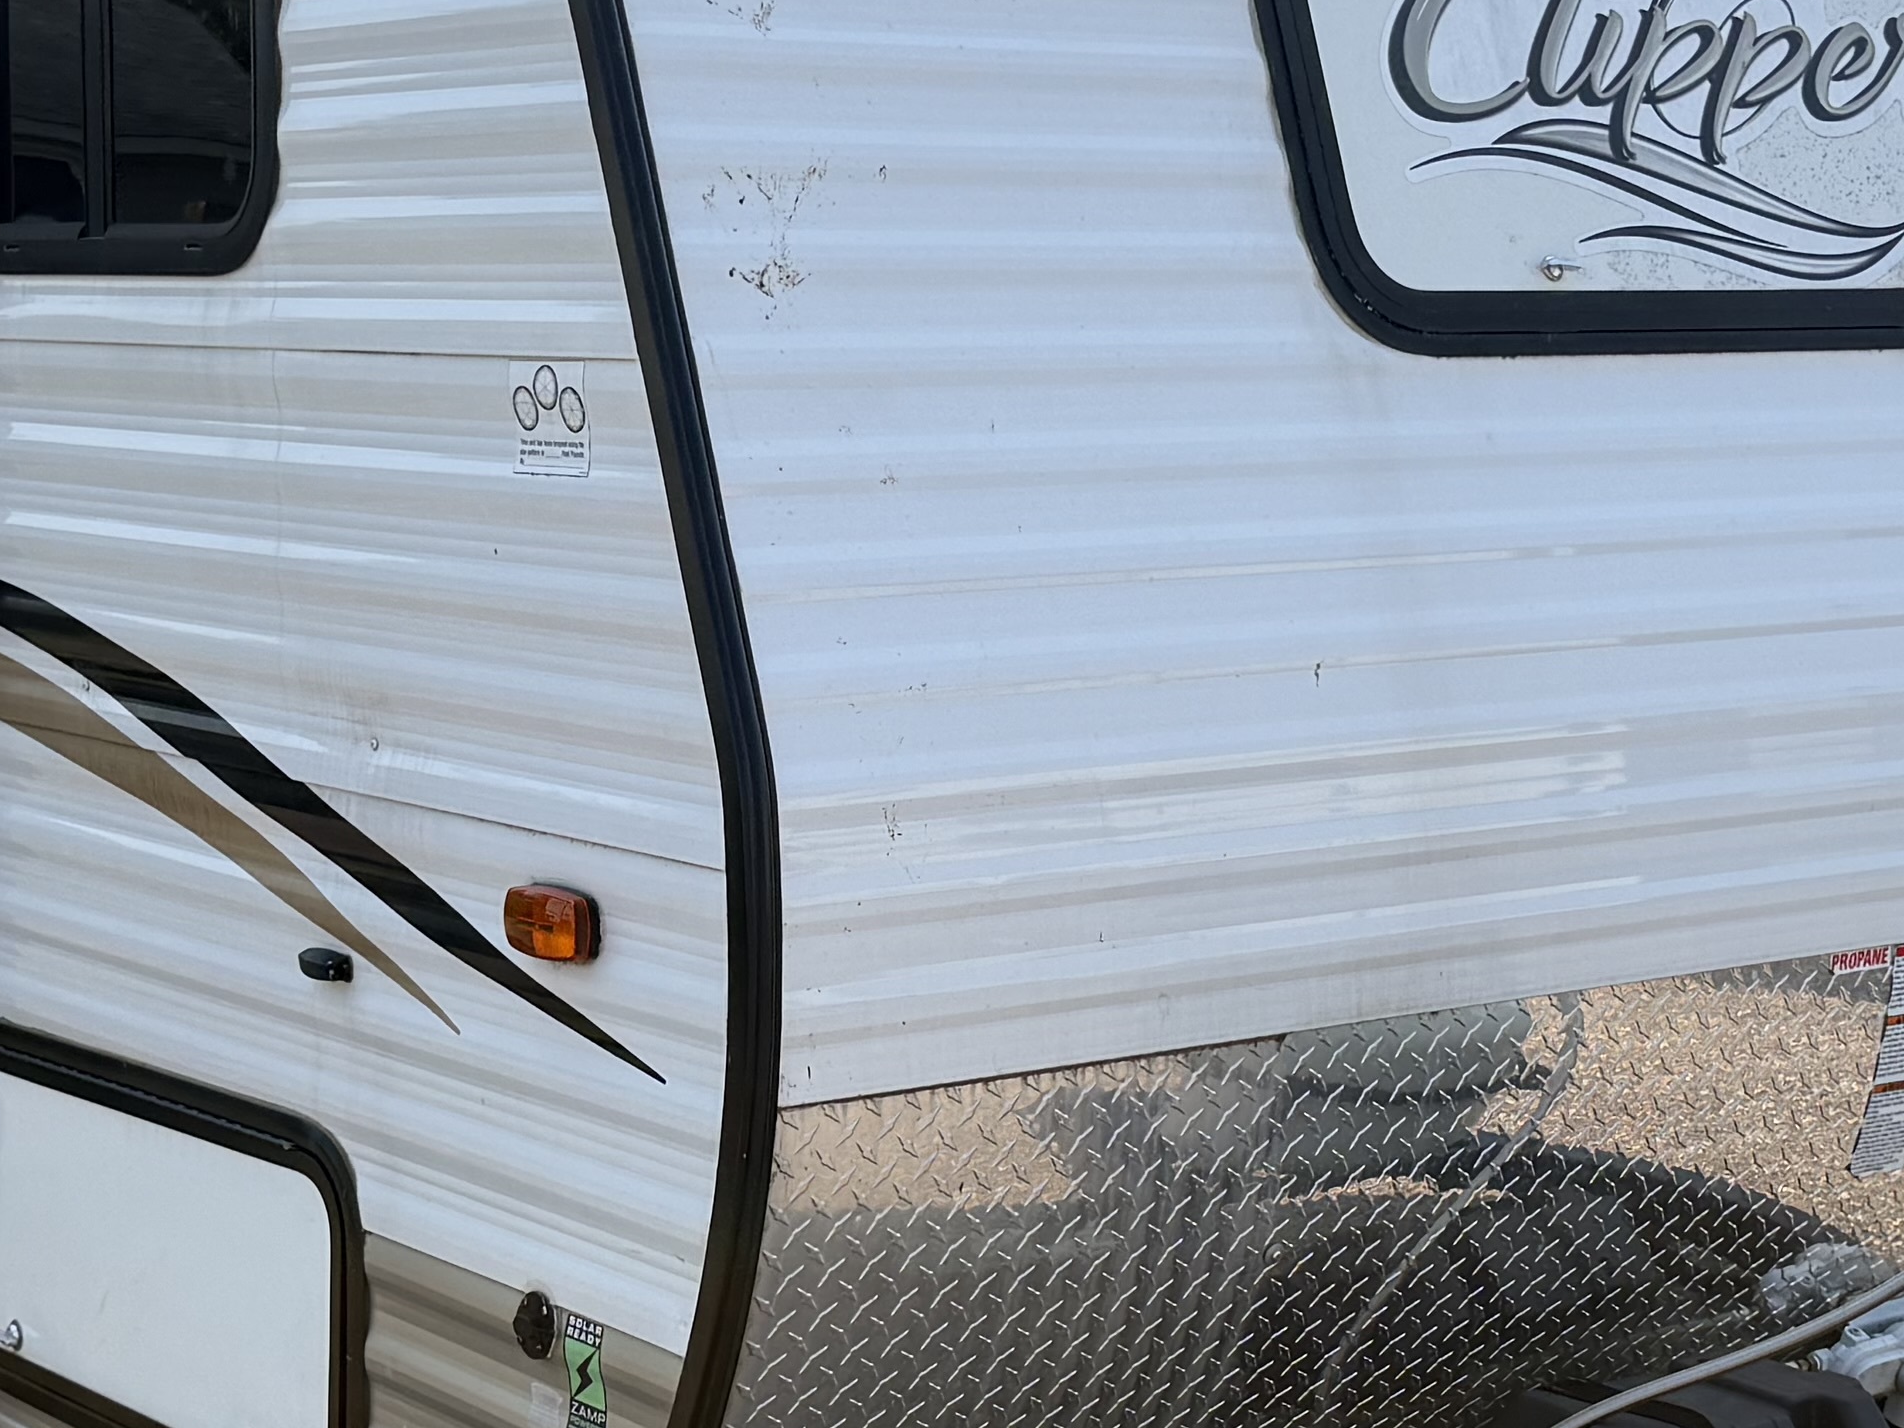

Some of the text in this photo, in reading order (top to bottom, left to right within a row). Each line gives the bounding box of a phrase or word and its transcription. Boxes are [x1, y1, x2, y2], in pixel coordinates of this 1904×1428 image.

[1831, 946, 1889, 972] PROPANE
[566, 1326, 601, 1347] READY
[569, 1315, 603, 1336] SOLAR
[571, 1401, 606, 1424] ZAMP
